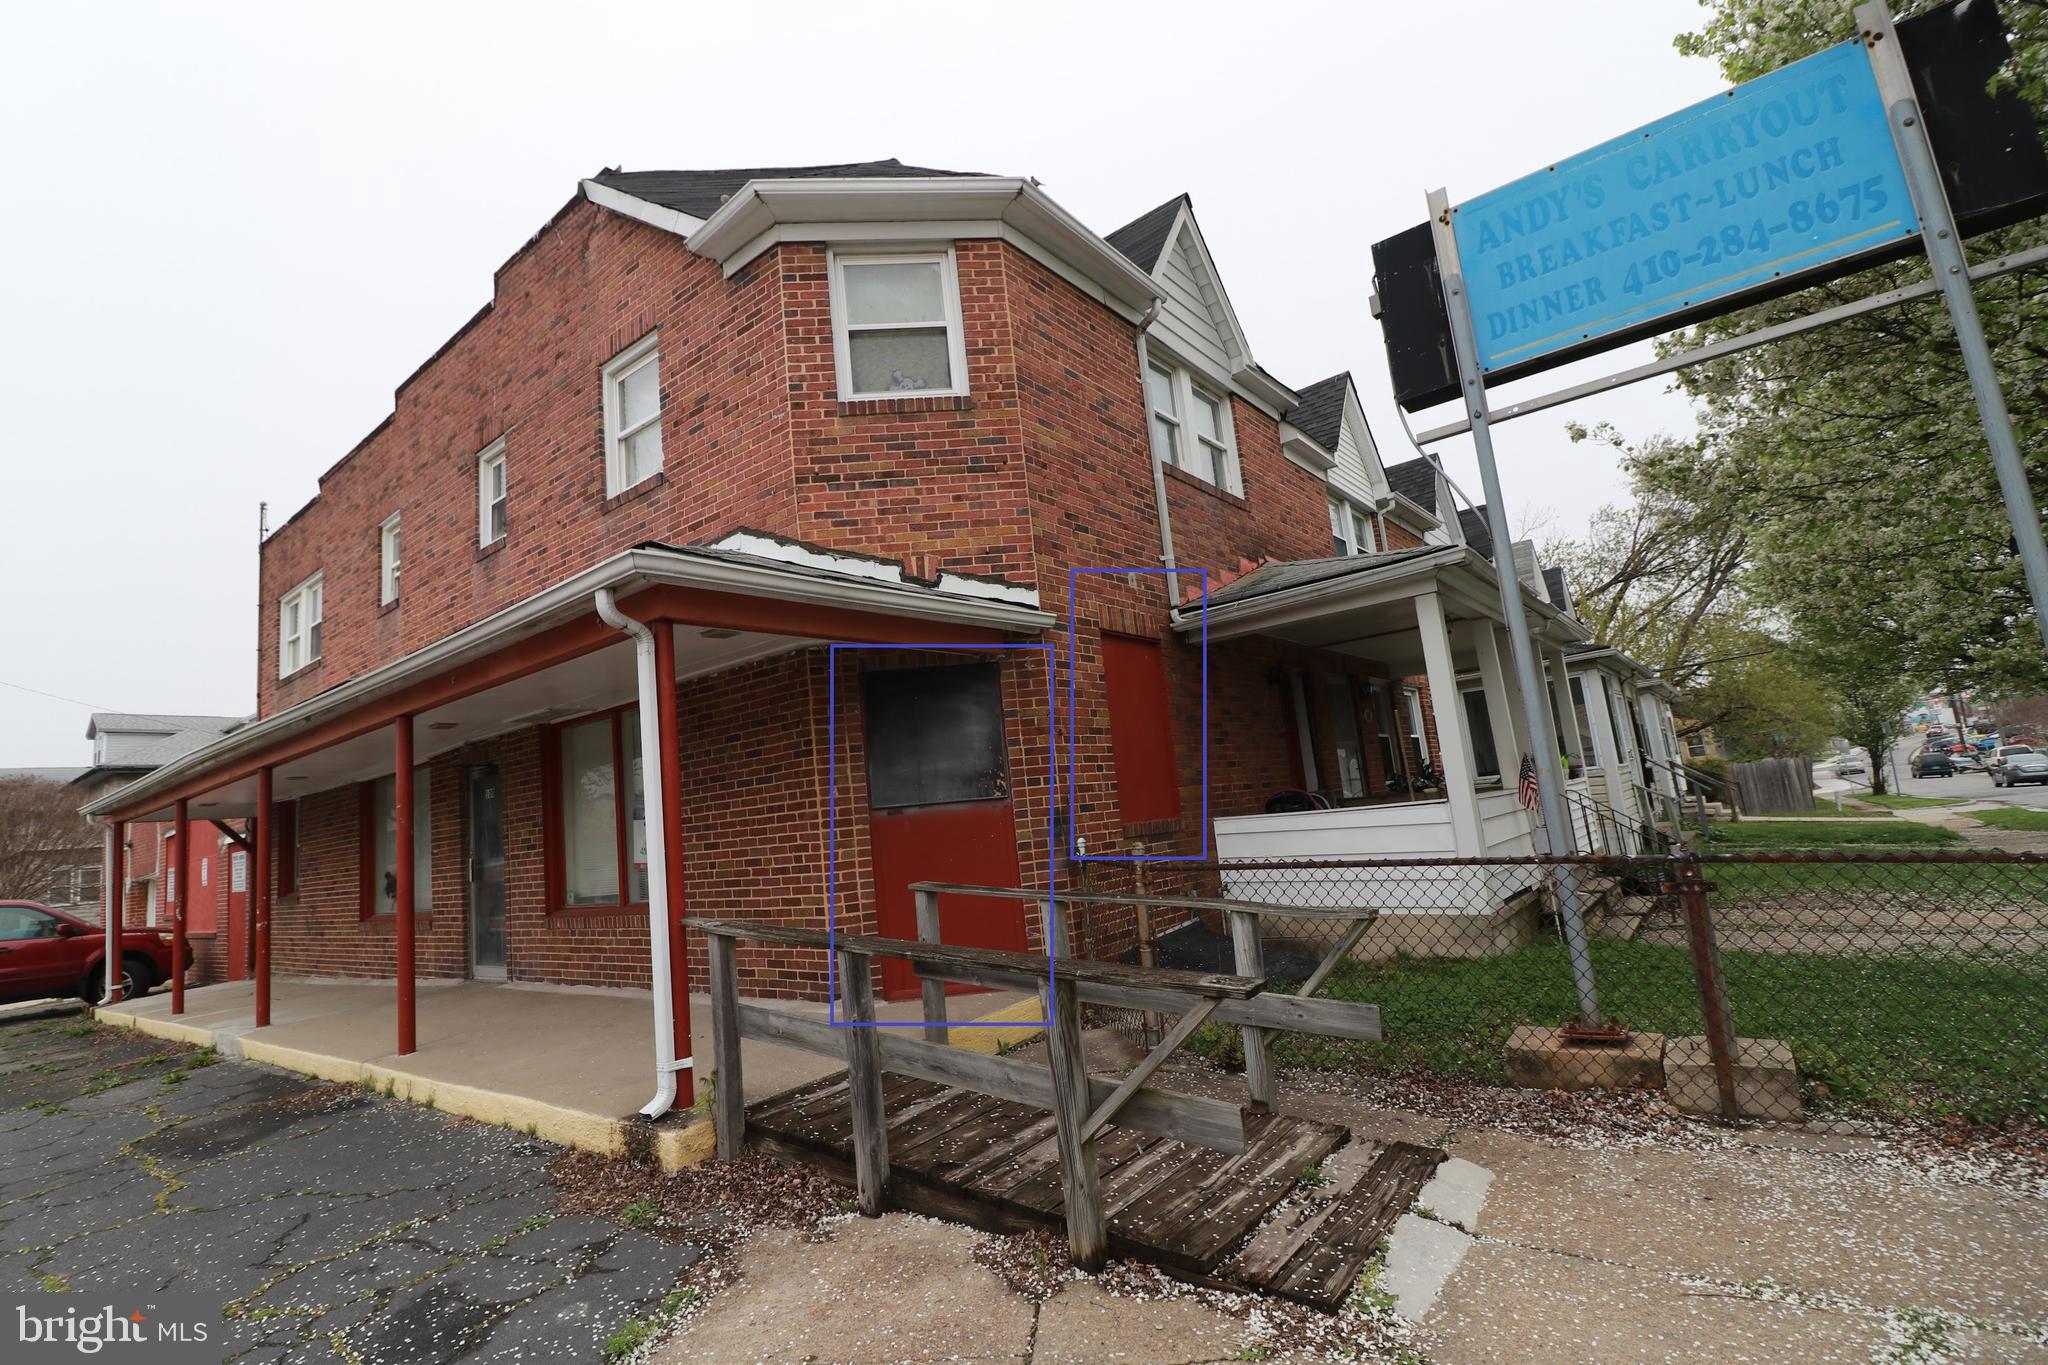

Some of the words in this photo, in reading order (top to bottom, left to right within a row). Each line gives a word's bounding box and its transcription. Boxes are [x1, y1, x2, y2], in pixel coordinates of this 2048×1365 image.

[1478, 173, 1606, 254] ANDY'S
[1625, 73, 1848, 191] CARRYOUT
[1486, 275, 1607, 340] DINNER
[1622, 174, 1889, 296] 410-284-8675
